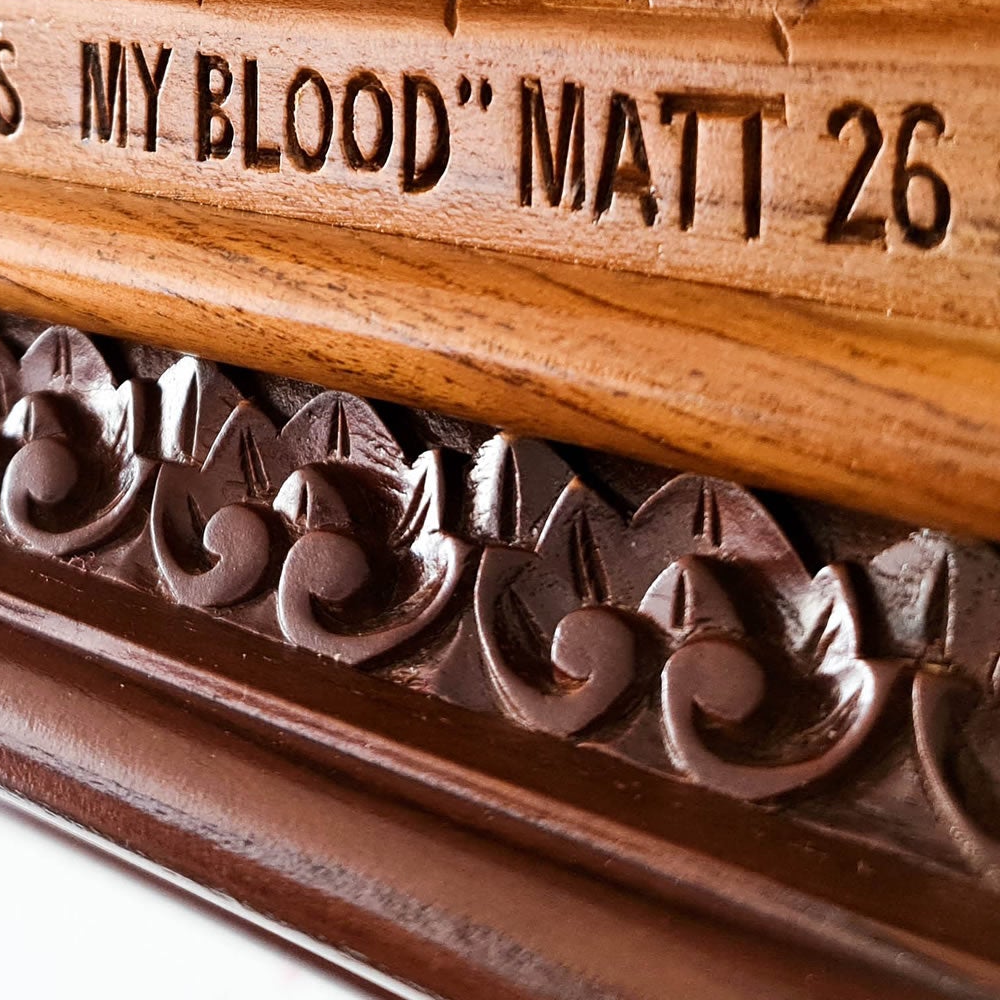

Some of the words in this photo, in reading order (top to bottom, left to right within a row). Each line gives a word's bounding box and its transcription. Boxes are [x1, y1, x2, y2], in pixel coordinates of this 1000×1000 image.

[80, 41, 172, 153] MY
[518, 77, 787, 241] MATT
[823, 101, 951, 250] 26
